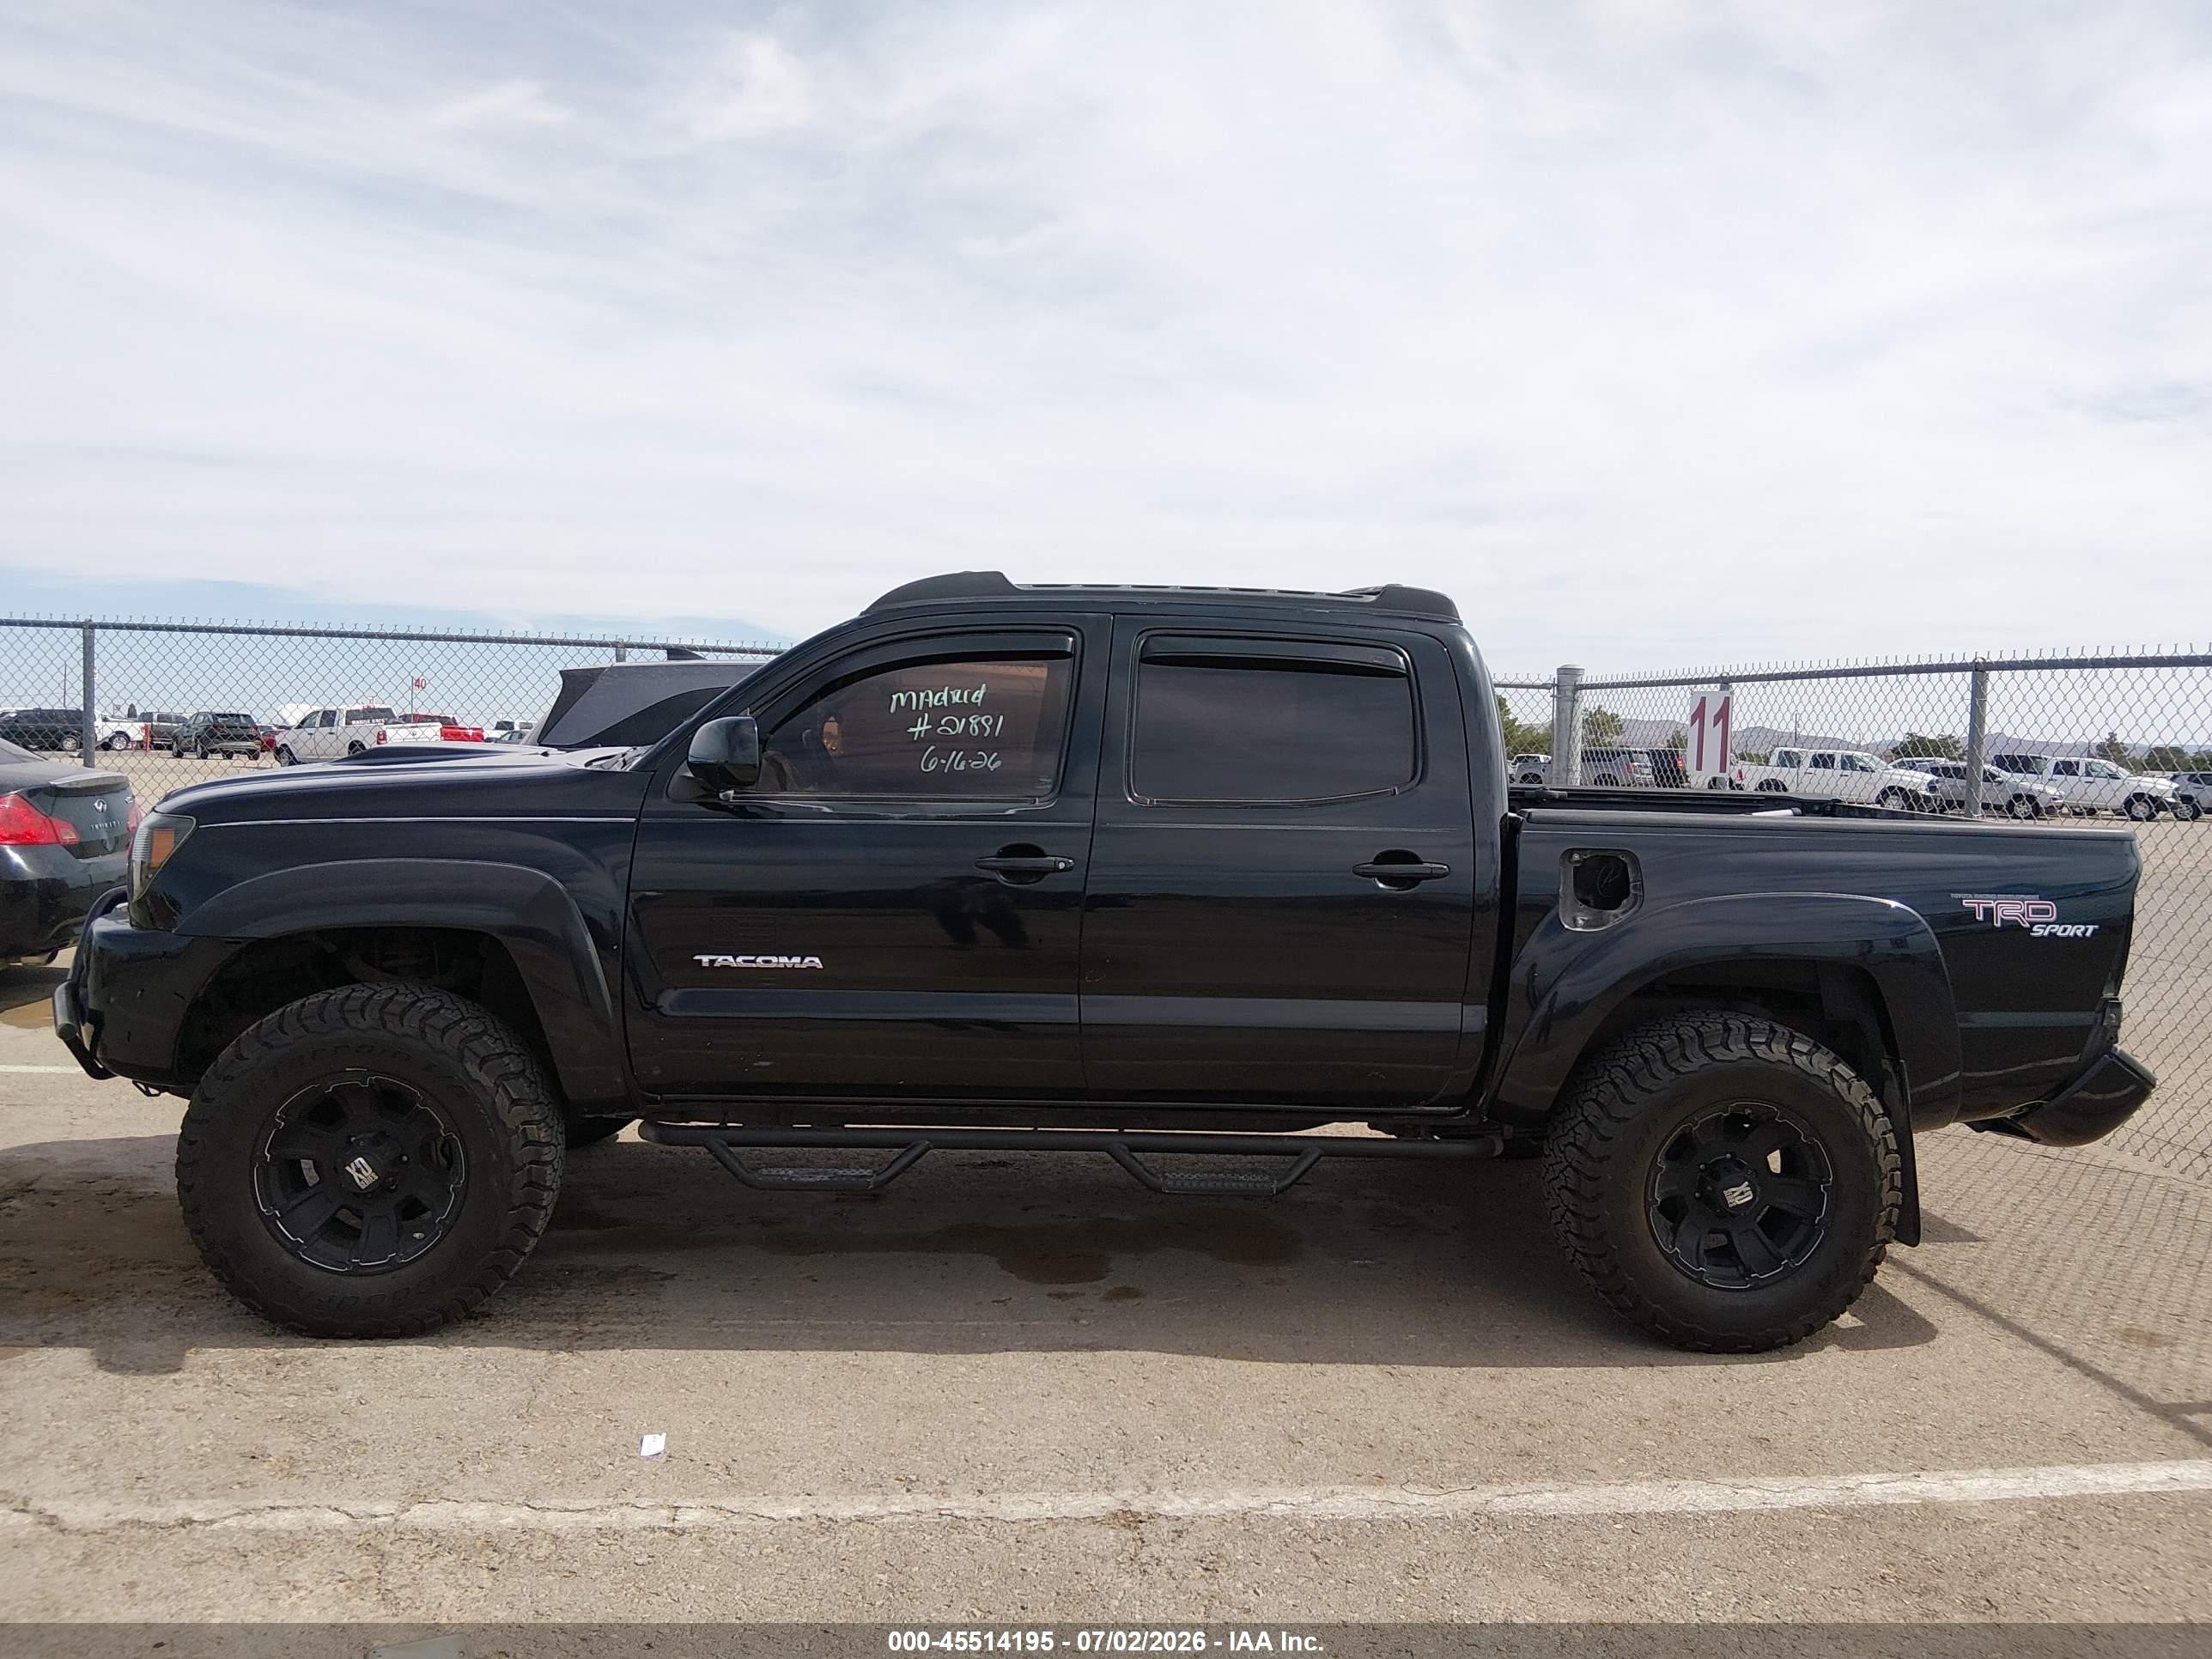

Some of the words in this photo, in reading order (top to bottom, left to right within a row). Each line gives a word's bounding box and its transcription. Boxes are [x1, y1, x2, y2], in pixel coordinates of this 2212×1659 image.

[414, 678, 427, 690] 40
[1690, 696, 1730, 774] 11
[1962, 899, 2057, 928] TRD
[2030, 924, 2100, 938] SPORT
[693, 954, 824, 969] TACOMA
[344, 1157, 373, 1186] XD
